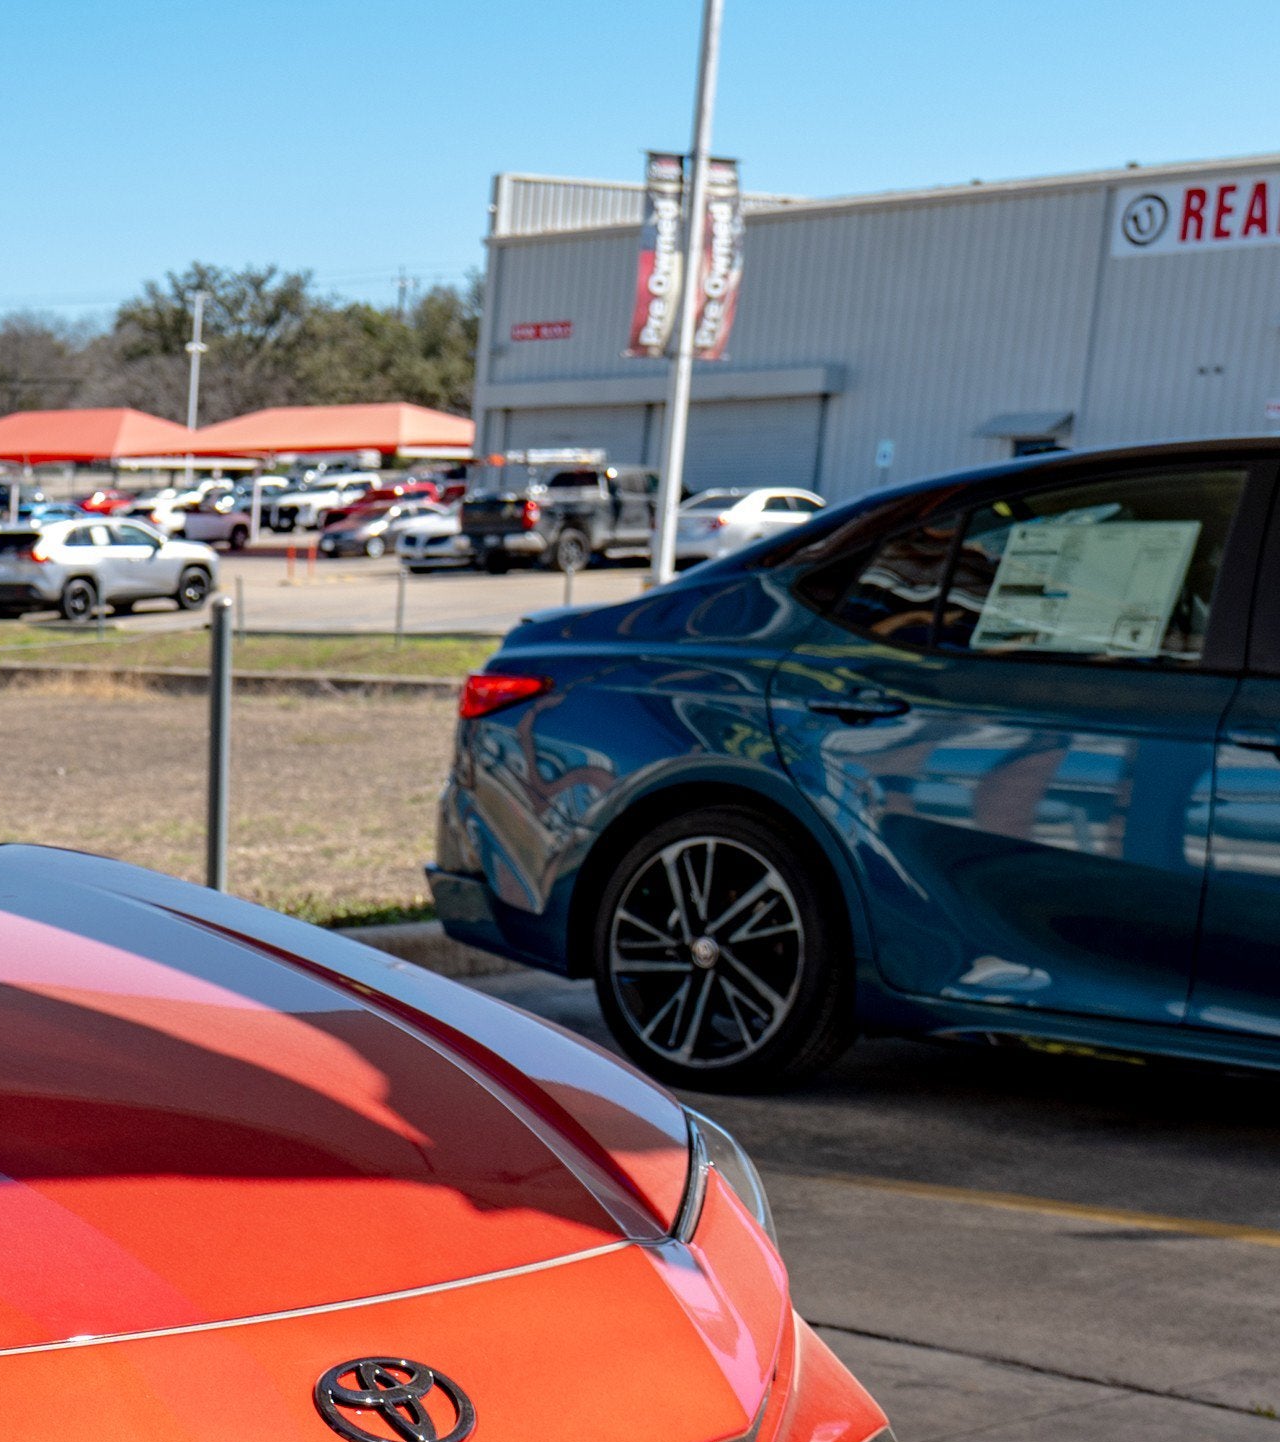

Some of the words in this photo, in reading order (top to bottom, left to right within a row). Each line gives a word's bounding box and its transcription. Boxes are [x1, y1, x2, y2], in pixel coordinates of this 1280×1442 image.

[1179, 181, 1280, 242] REA
[648, 200, 679, 297] Owned
[704, 202, 733, 298] Owned
[639, 299, 667, 346] Pre
[694, 300, 722, 348] Pre
